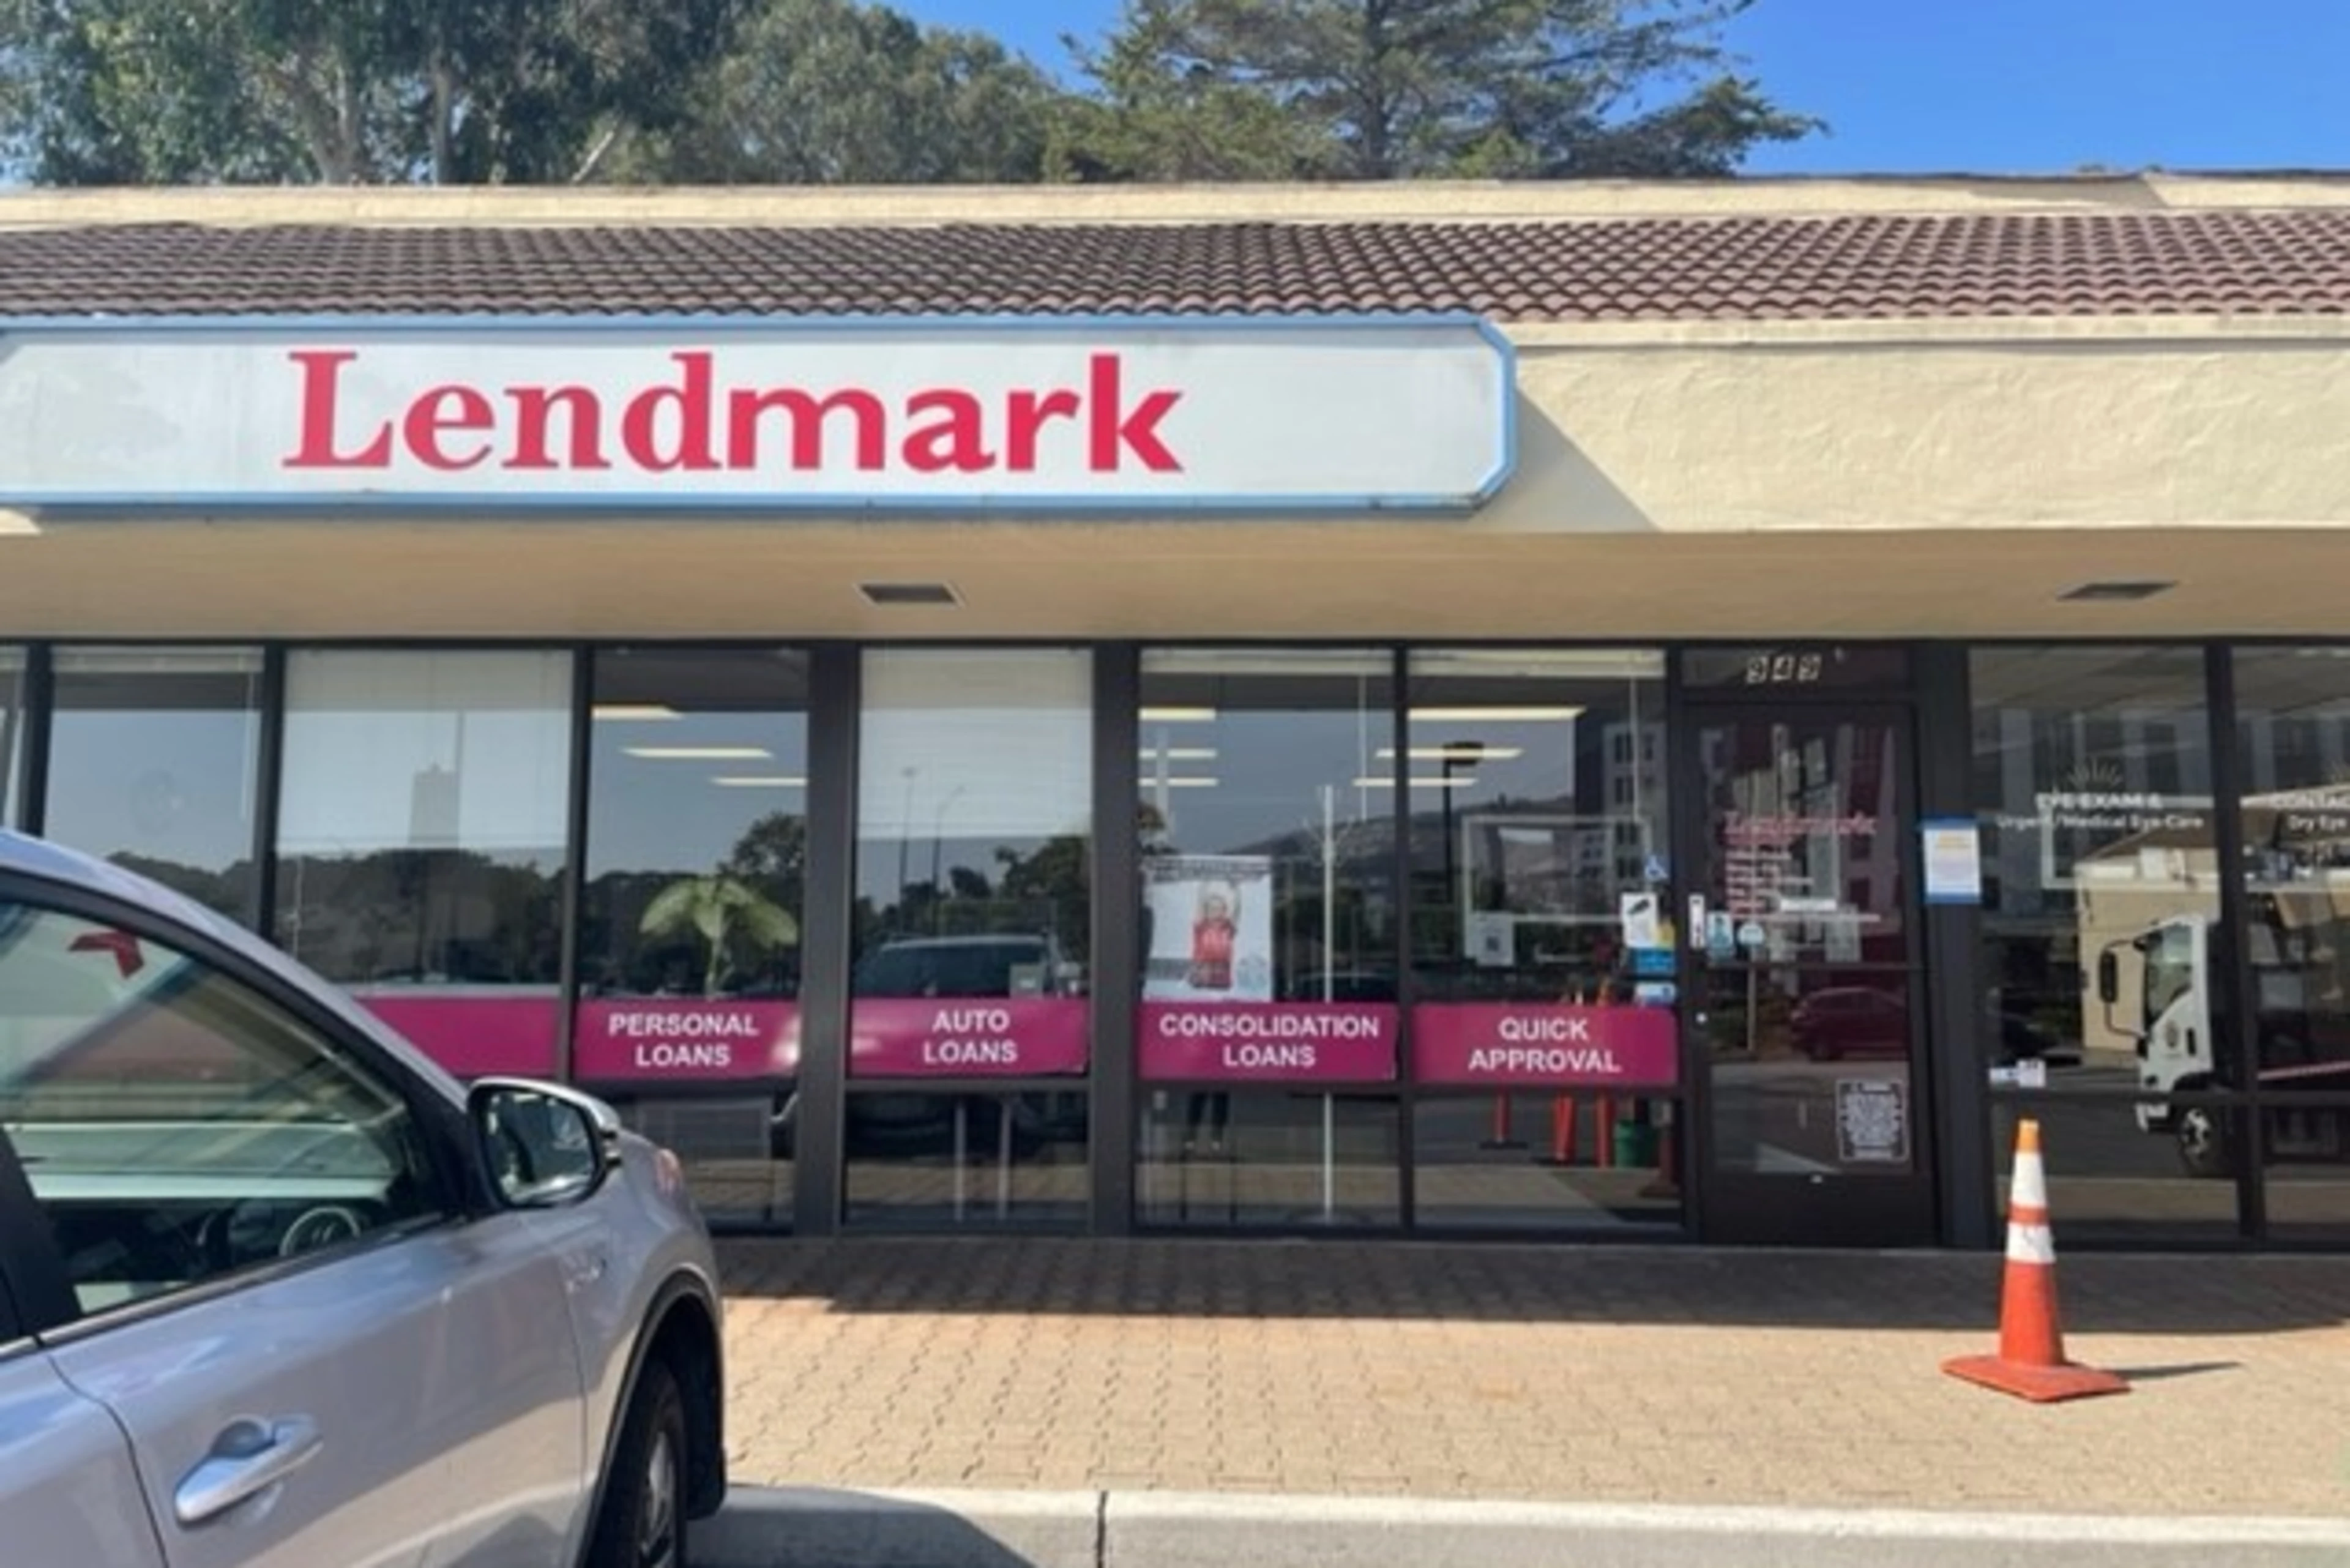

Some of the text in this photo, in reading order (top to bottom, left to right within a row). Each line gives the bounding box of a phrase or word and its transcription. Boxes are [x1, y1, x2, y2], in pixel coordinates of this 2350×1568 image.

[283, 351, 1184, 472] Lendmark
[608, 1013, 758, 1036] PERSONAL
[932, 1009, 1010, 1032] AUTO
[1160, 1013, 1379, 1037] CONSOLIDATION
[1498, 1017, 1589, 1041] QUICK
[636, 1044, 730, 1067] LOANS
[923, 1039, 1018, 1063] LOANS
[1224, 1044, 1316, 1067] LOANS
[1469, 1048, 1620, 1072] APPROVAL
